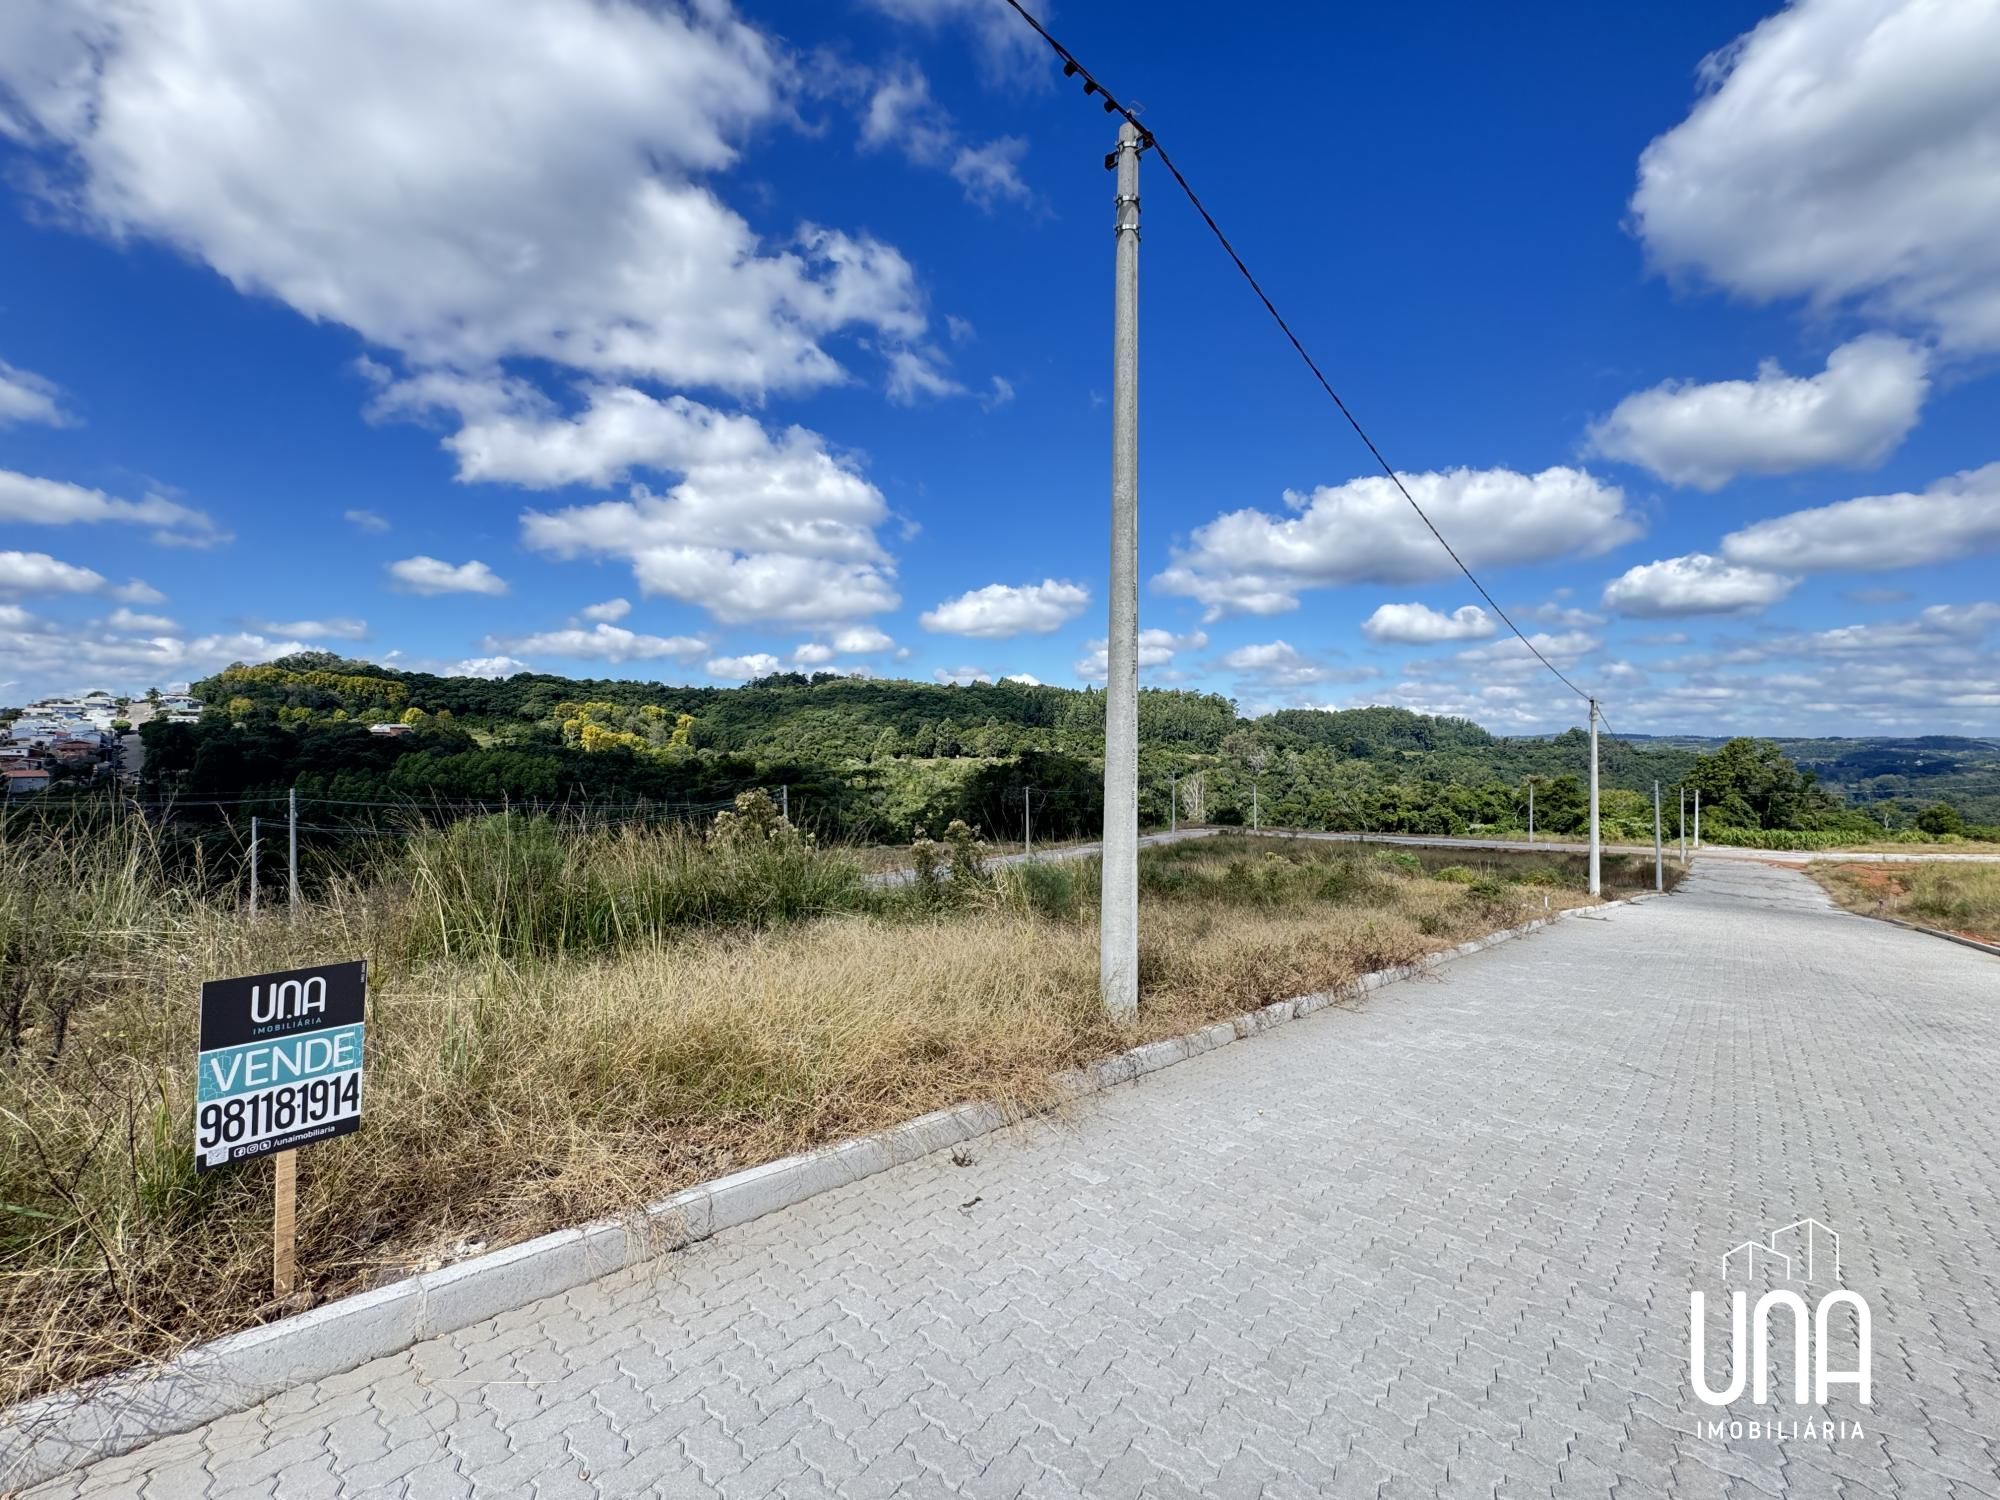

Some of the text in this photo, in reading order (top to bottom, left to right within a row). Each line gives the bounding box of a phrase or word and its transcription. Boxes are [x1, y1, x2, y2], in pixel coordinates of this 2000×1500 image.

[251, 976, 326, 1023] UNA
[252, 1017, 322, 1036] IMOBILIÁRIA
[211, 1031, 356, 1092] VENDE
[273, 1125, 336, 1148] /unaimobiliaria
